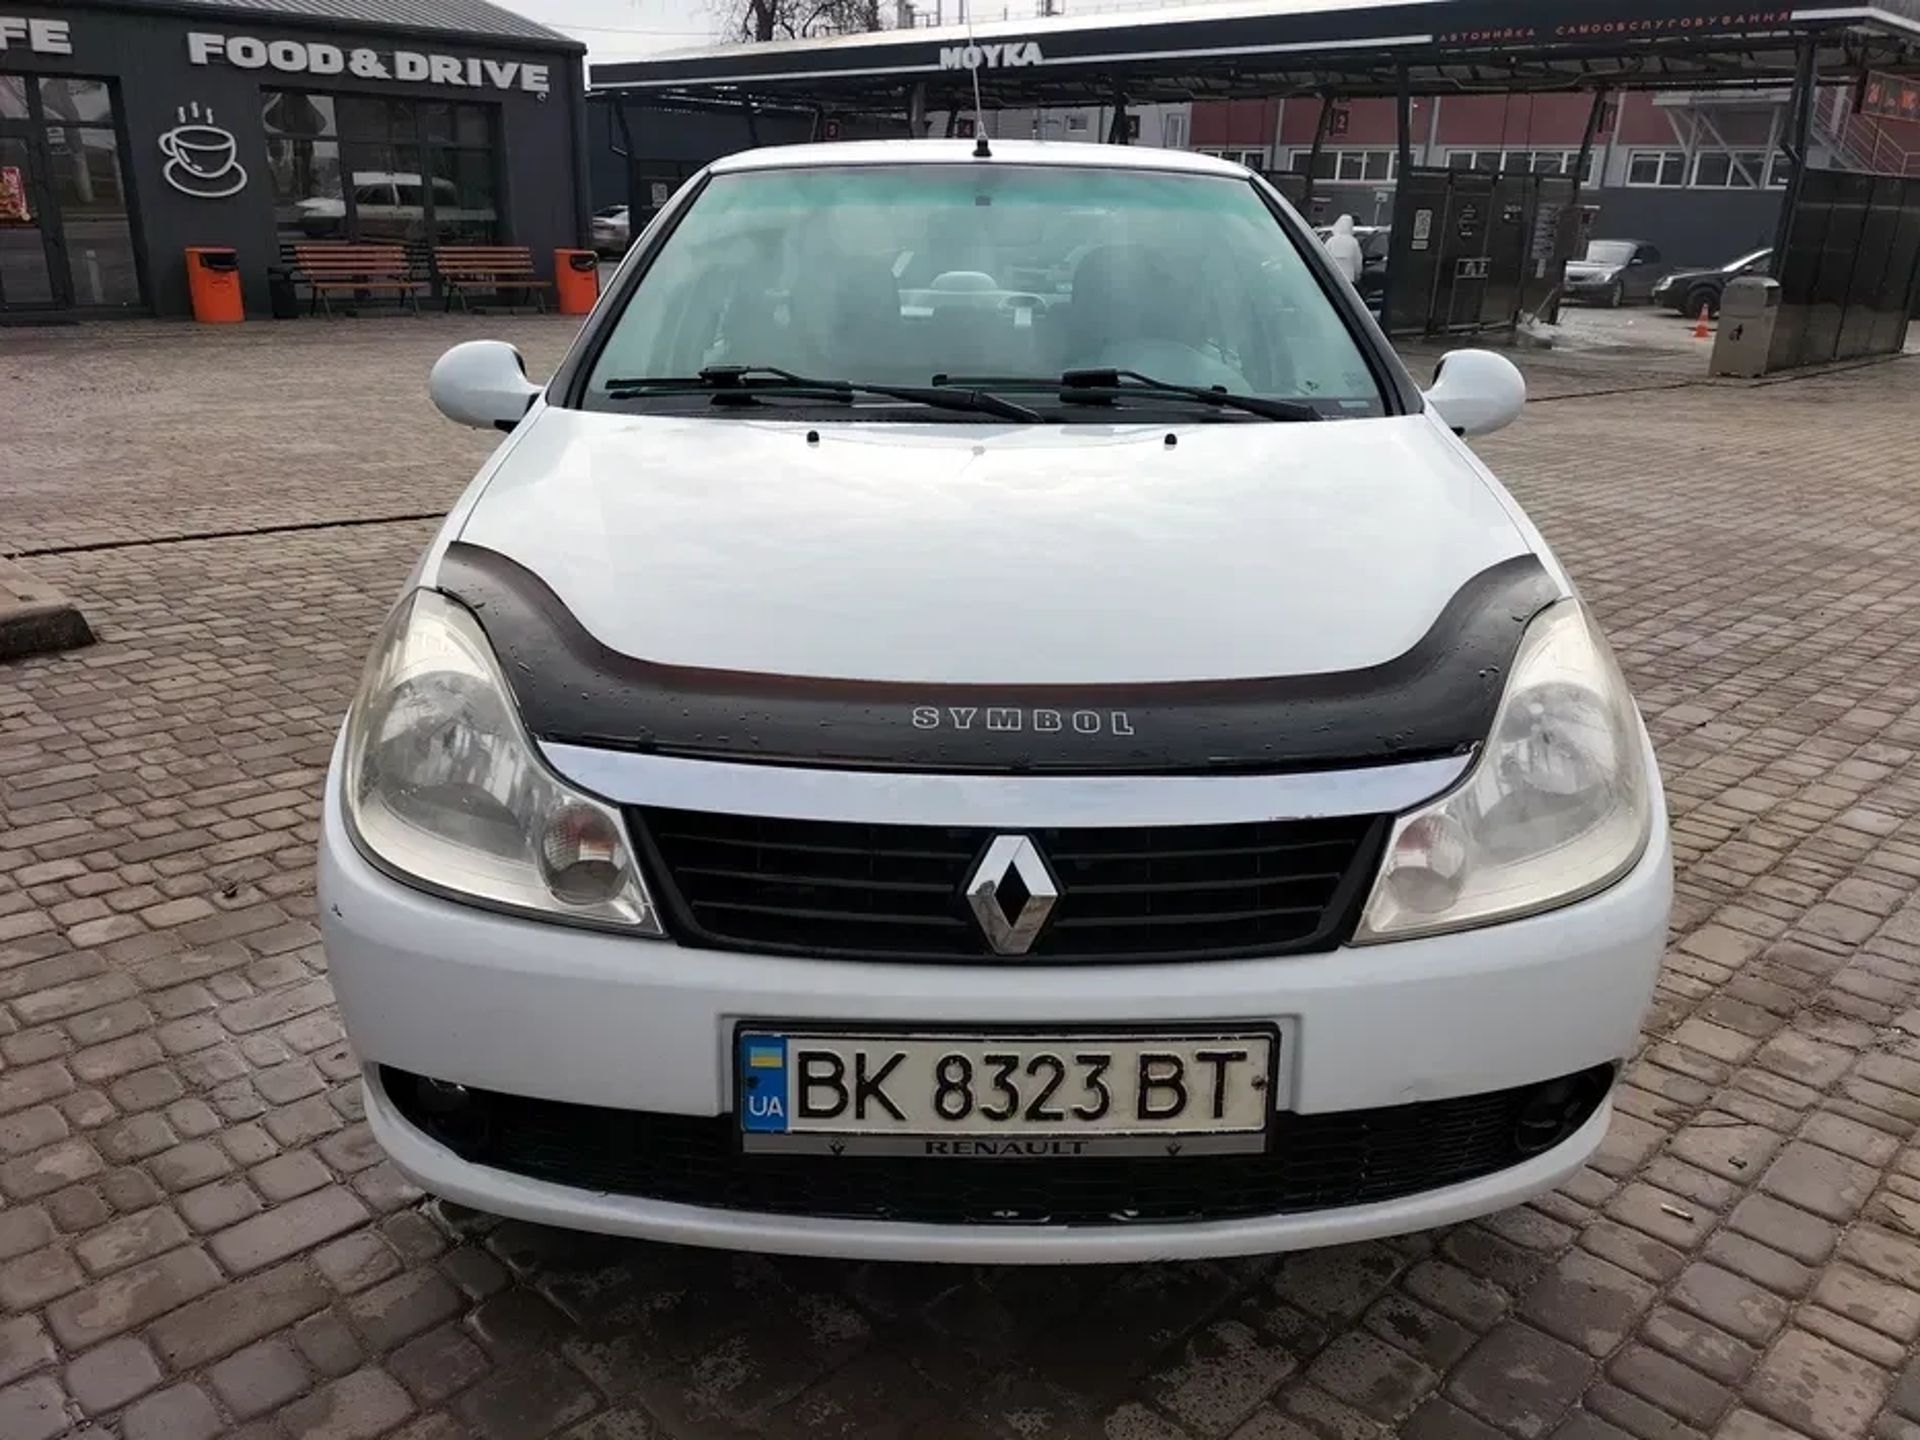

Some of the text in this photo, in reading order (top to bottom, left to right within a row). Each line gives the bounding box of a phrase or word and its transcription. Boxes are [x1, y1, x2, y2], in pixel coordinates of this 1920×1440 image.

[940, 42, 1044, 70] MOYKA
[912, 706, 1135, 736] SYMBOL
[798, 1050, 1248, 1122] BK 8323 BT
[749, 1096, 785, 1118] UA
[925, 1140, 1089, 1155] RENAULT
